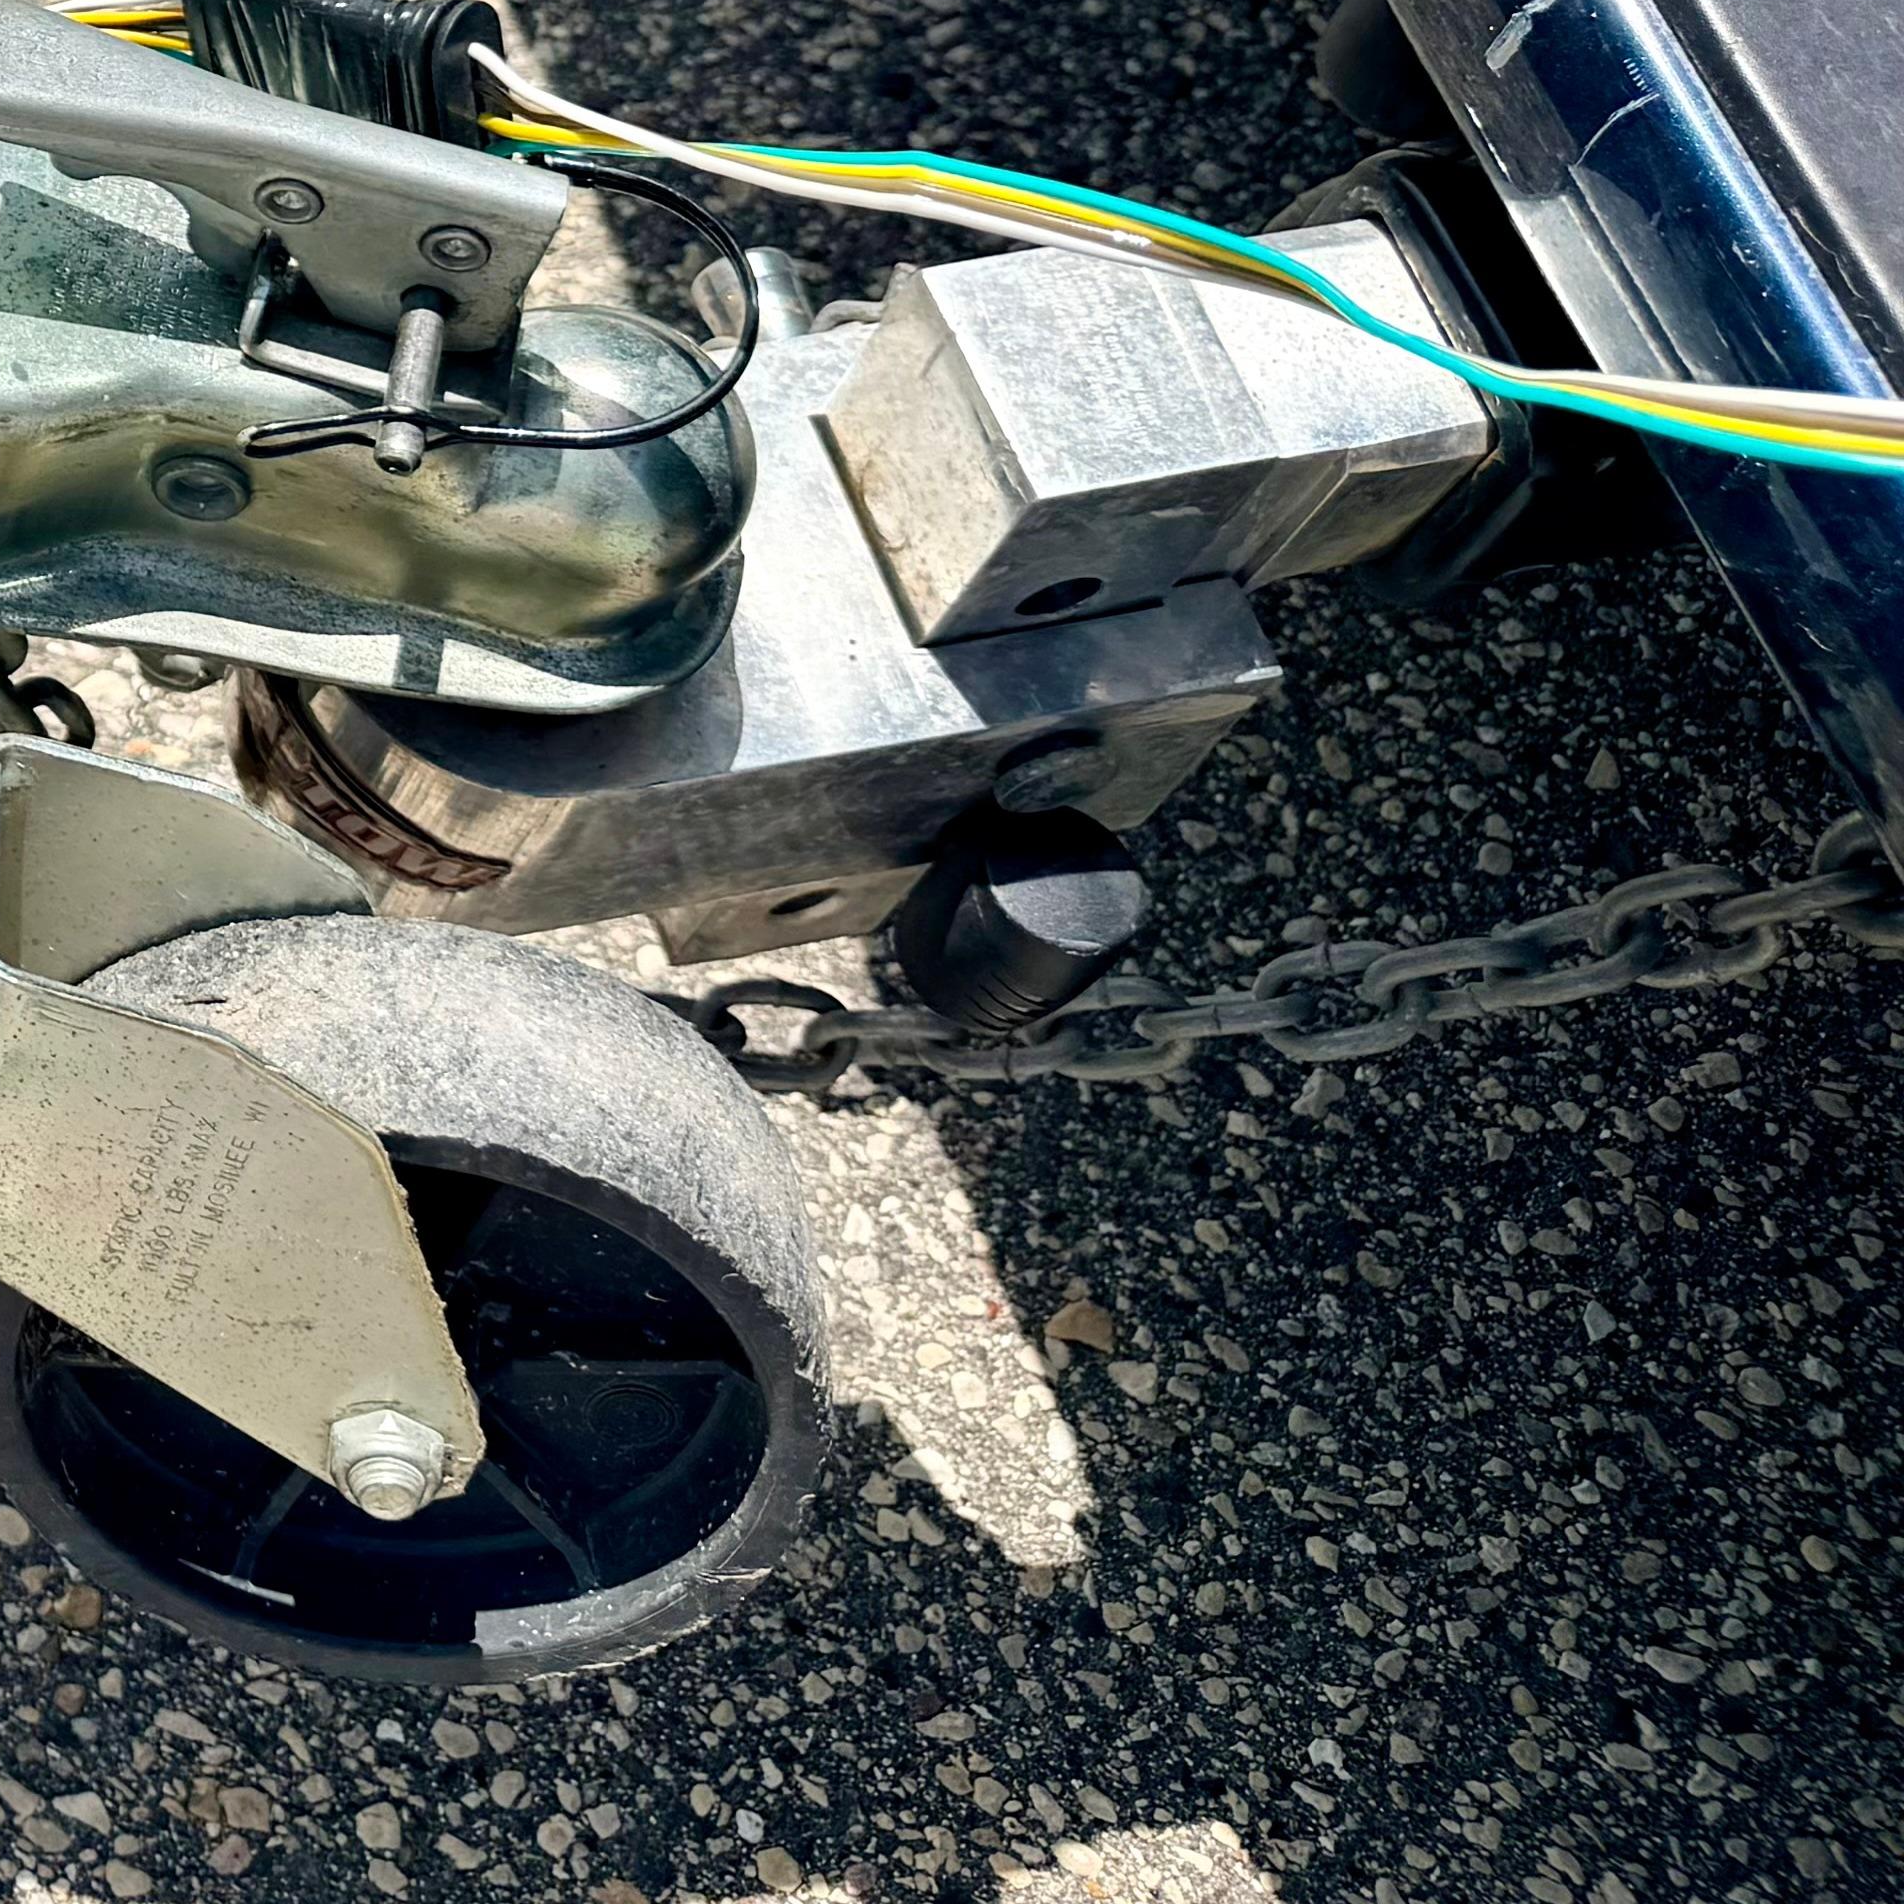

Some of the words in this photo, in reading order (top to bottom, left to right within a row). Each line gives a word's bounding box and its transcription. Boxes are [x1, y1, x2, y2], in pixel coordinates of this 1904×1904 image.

[99, 1204, 143, 1265] STATIC
[129, 1097, 185, 1197] CAPACITY
[164, 1229, 214, 1305] FULTON
[199, 1135, 256, 1224] MOSINEE
[243, 1099, 271, 1124] WI
